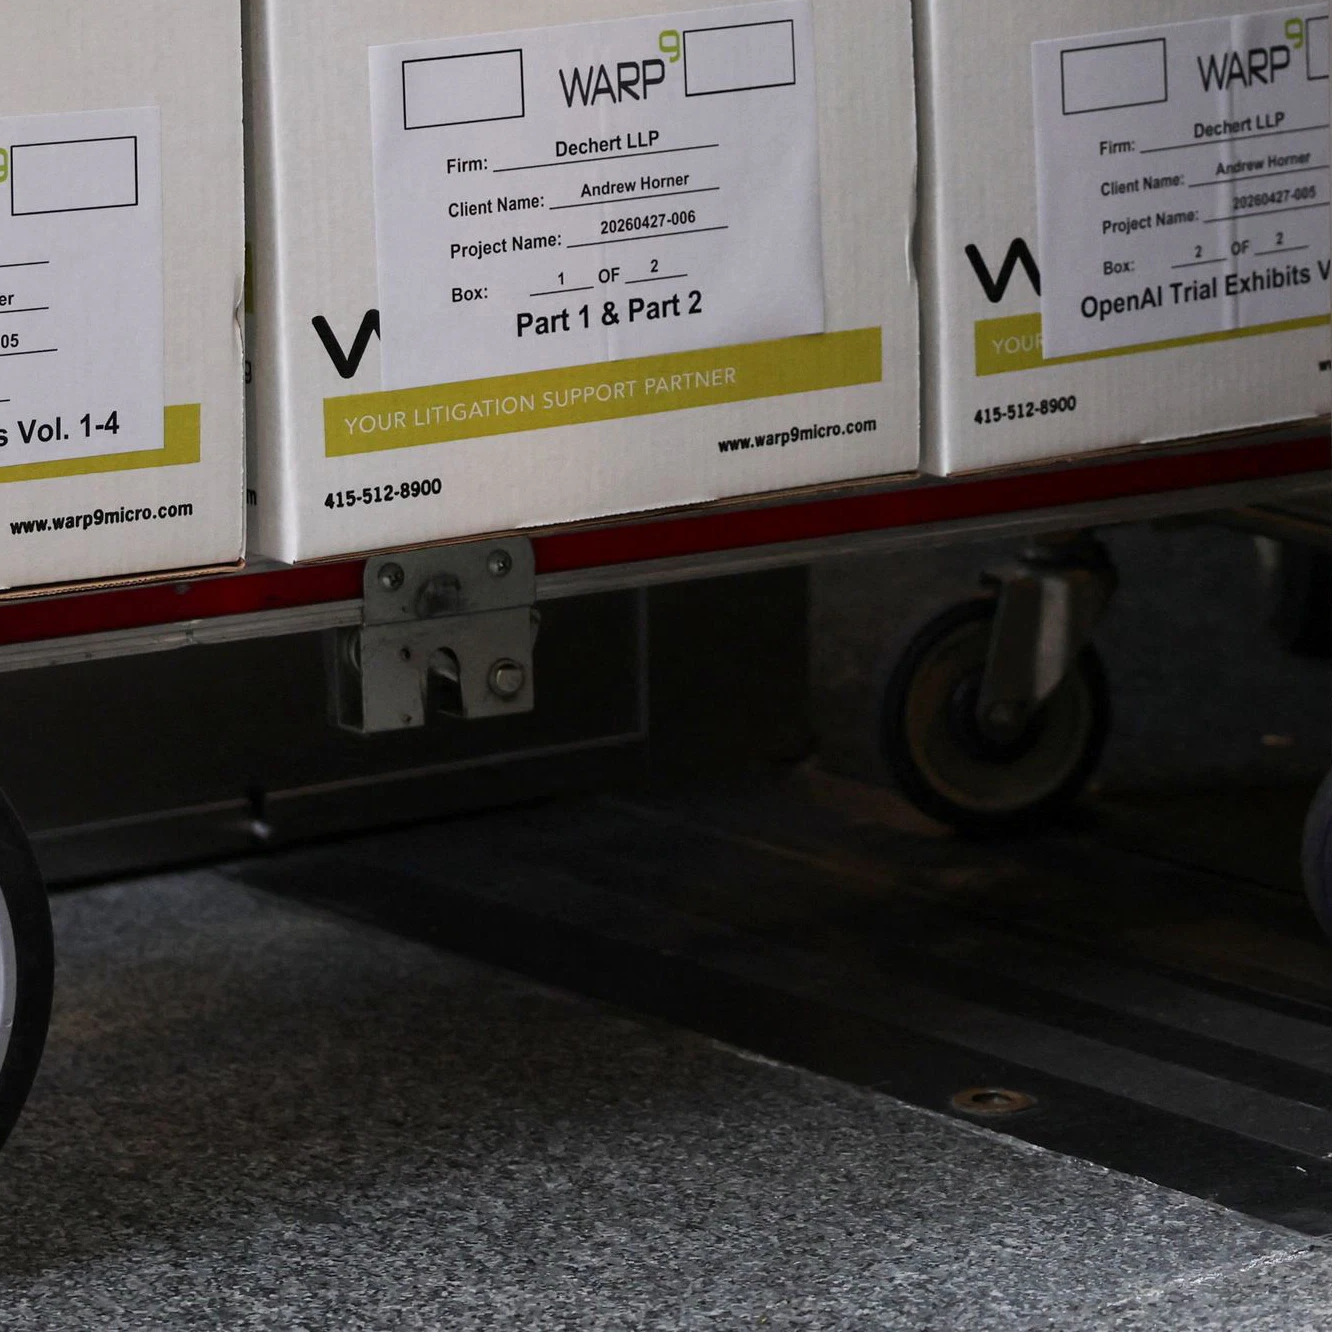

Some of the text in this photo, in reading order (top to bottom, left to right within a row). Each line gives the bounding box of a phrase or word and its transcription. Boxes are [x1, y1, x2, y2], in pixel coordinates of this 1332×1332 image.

[447, 130, 659, 174] Firm: Dechert LLP
[1099, 111, 1285, 156] Firm: Dechert LLP
[448, 174, 690, 218] Client Name: Andrew Horner
[1100, 152, 1311, 196] Client Name: Andrew Horner
[451, 210, 696, 260] Project Name: 20260427-006
[1102, 215, 1152, 235] Project
[1156, 211, 1199, 227] Name:
[1103, 232, 1284, 275] Box: 2 OF 2
[452, 287, 488, 303] Box:
[598, 267, 620, 284] OF
[650, 259, 658, 273] 2
[1081, 285, 1162, 321] OpenAI
[1169, 277, 1217, 304] Trial
[1225, 265, 1311, 296] Exhibits
[517, 290, 702, 337] Part 1 & Part 2
[344, 367, 736, 435] YOUR LITIGATION SUPPORT PARTNER
[974, 395, 1077, 425] 415-512-8900
[17, 416, 69, 444] Vol.
[80, 410, 120, 437] 1-4
[718, 419, 877, 453] www.warp9micro.com
[324, 478, 442, 509] 415-512-8900
[10, 503, 193, 535] www.warp9micro.com
